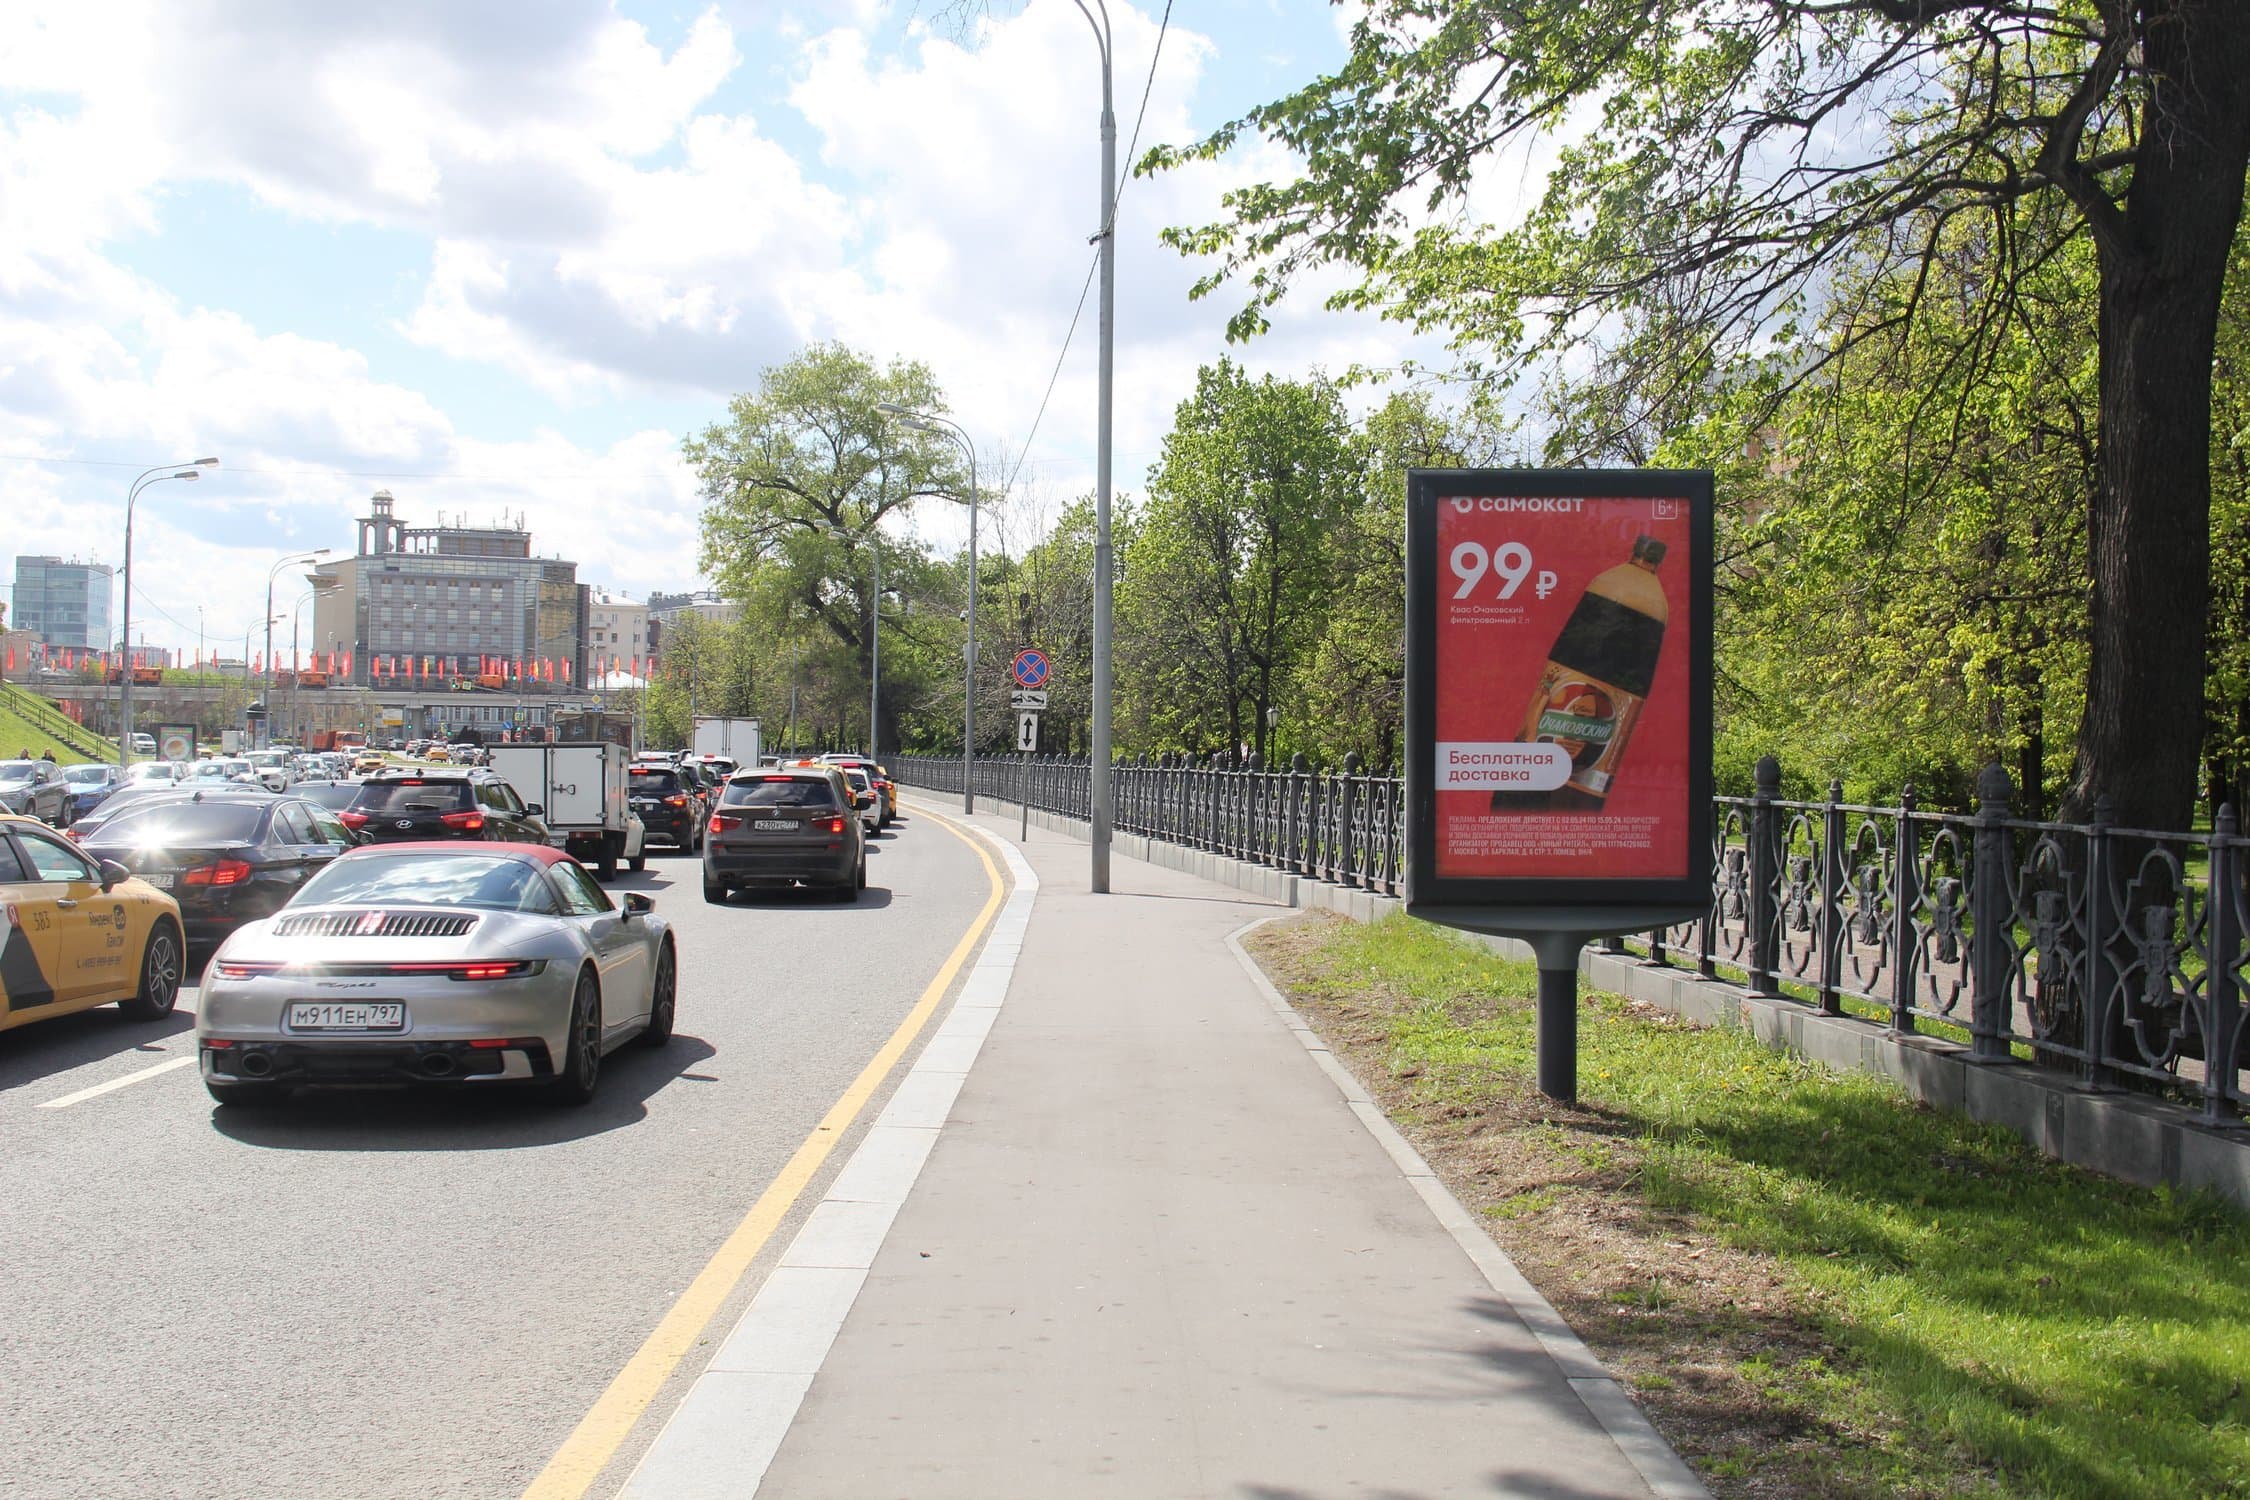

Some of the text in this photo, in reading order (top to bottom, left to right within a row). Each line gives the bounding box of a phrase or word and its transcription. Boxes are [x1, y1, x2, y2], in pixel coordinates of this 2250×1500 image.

[1478, 497, 1584, 513] самокат
[1657, 499, 1673, 515] 6+
[1451, 605, 1524, 614] Квас Очаковский
[1451, 615, 1517, 625] фильтрованный
[1449, 750, 1553, 766] Бесплатная
[1448, 771, 1531, 783] доставка
[32, 910, 51, 932] 583
[105, 932, 125, 948] Такси
